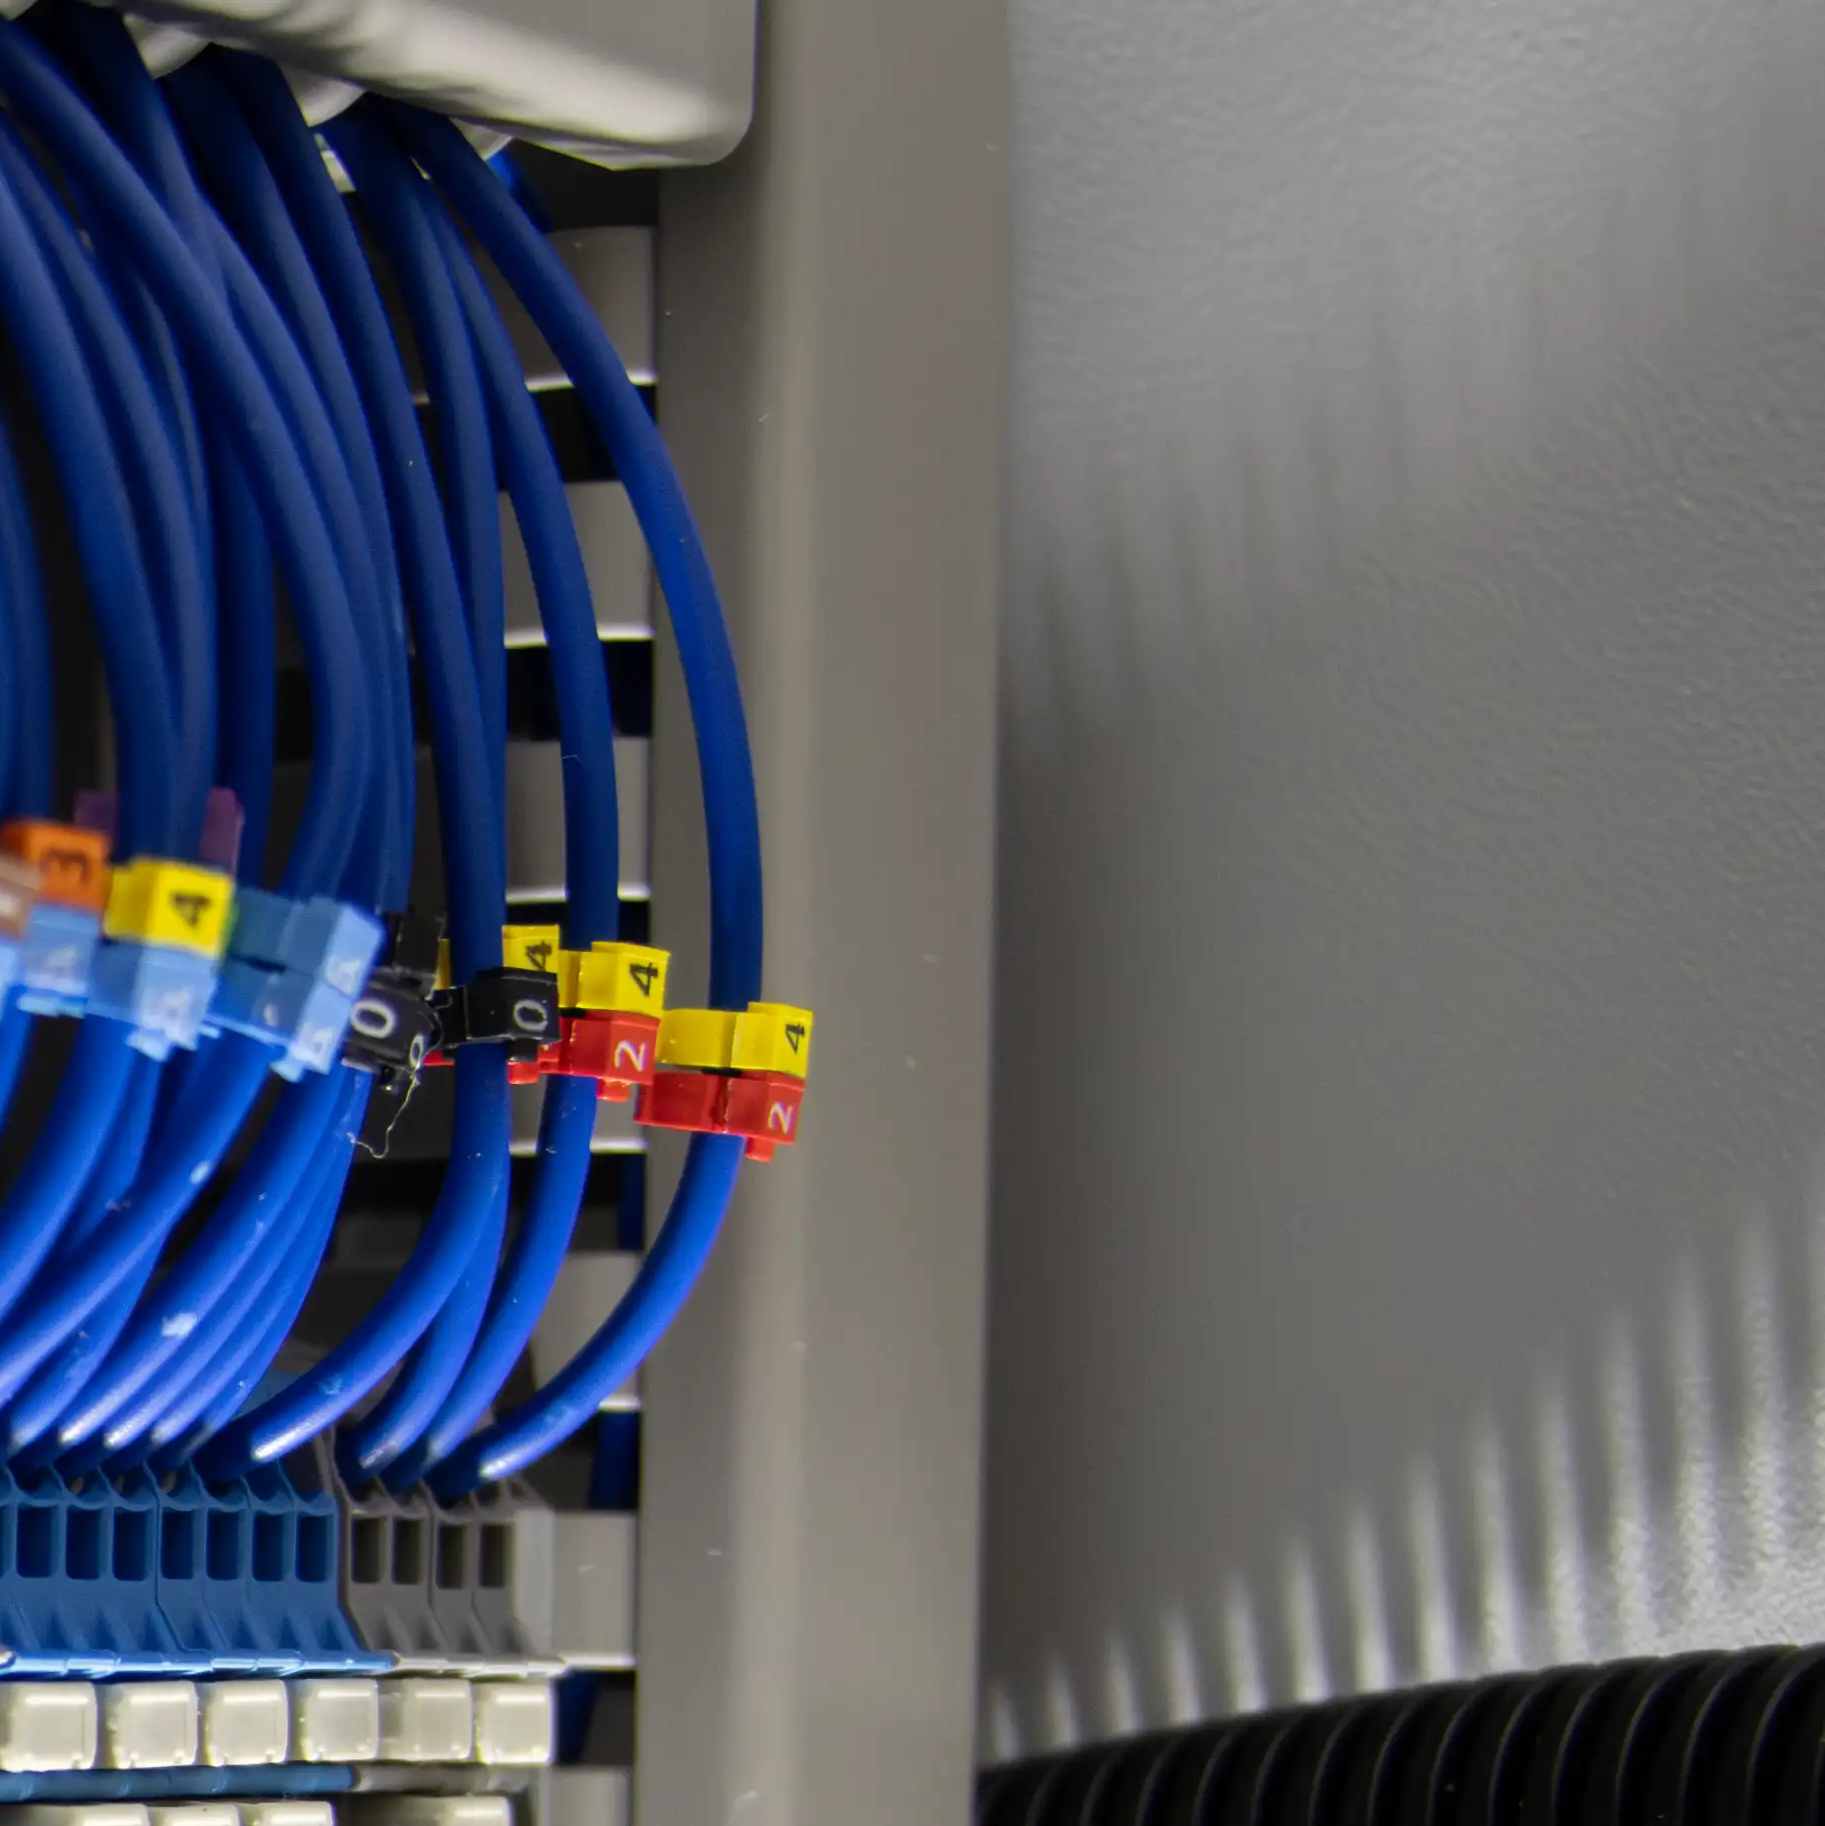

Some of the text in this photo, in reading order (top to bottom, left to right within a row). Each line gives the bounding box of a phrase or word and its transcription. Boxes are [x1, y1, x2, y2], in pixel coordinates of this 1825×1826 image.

[167, 890, 212, 928] 4
[351, 998, 395, 1039] 0
[512, 999, 549, 1032] 0
[613, 960, 660, 1073] 2 4
[767, 1022, 806, 1134] 2 4
